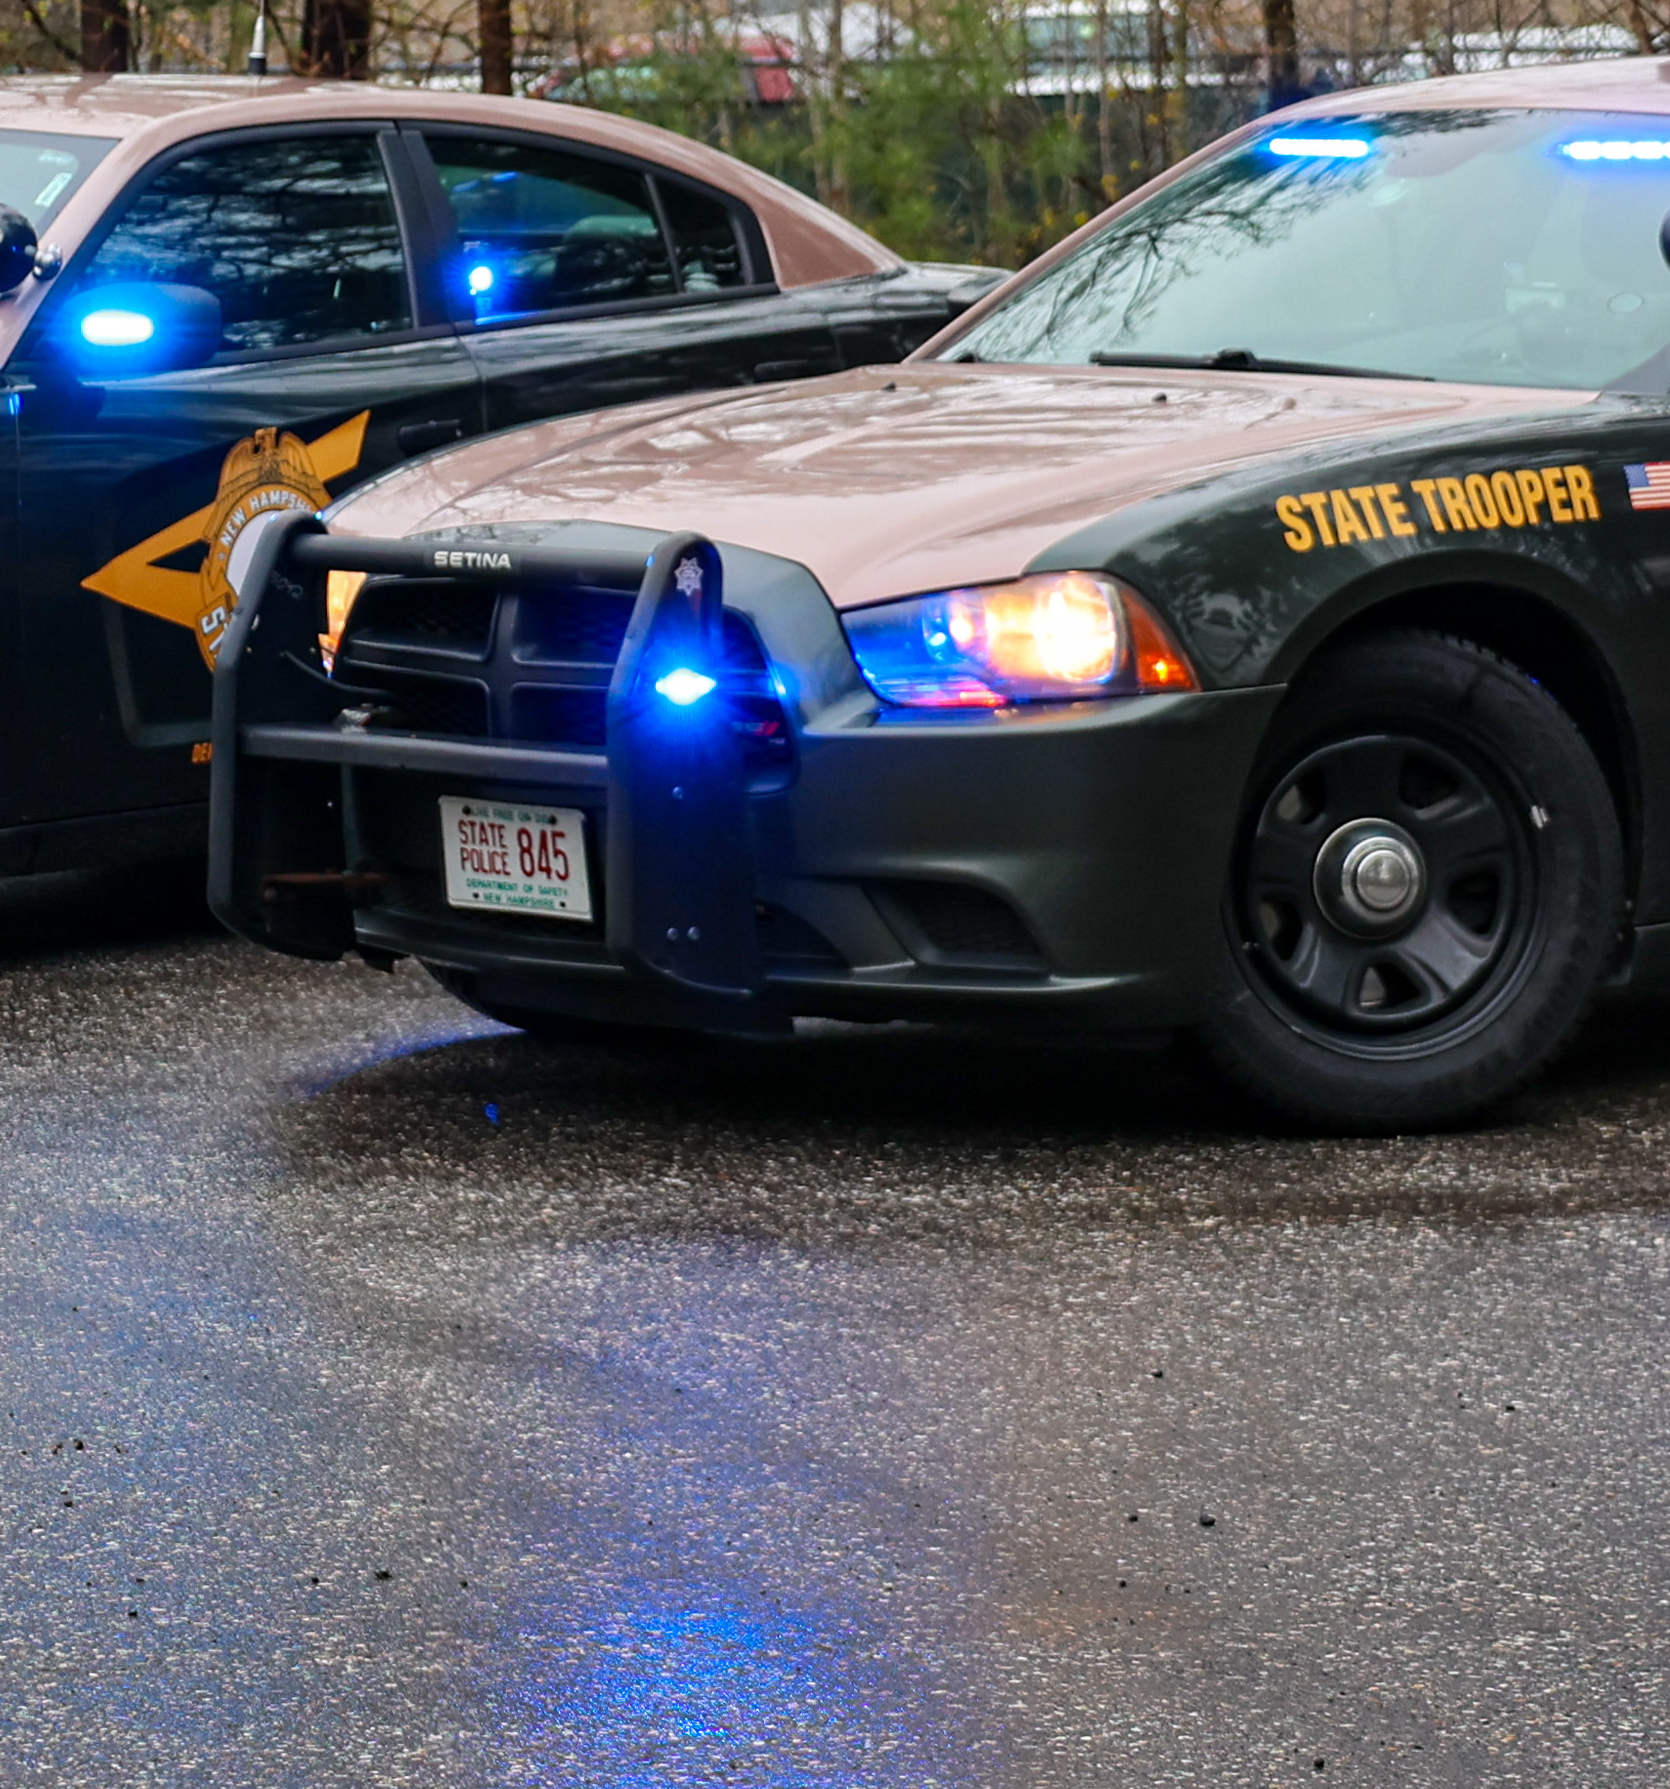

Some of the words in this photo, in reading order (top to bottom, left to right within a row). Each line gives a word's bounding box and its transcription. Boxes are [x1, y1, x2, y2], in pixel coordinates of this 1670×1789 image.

[1275, 482, 1419, 553] STATE
[1410, 464, 1601, 534] TROOPER
[219, 506, 249, 548] NEW
[434, 550, 512, 569] SETINA
[458, 818, 508, 849] STATE
[517, 827, 570, 882] 845
[460, 847, 512, 876] POLICE
[467, 877, 518, 892] DEPARTMENT
[522, 883, 533, 893] OF
[538, 885, 569, 898] SAFETY
[483, 893, 502, 903] NEW
[506, 895, 556, 909] HAMPSHIRE
